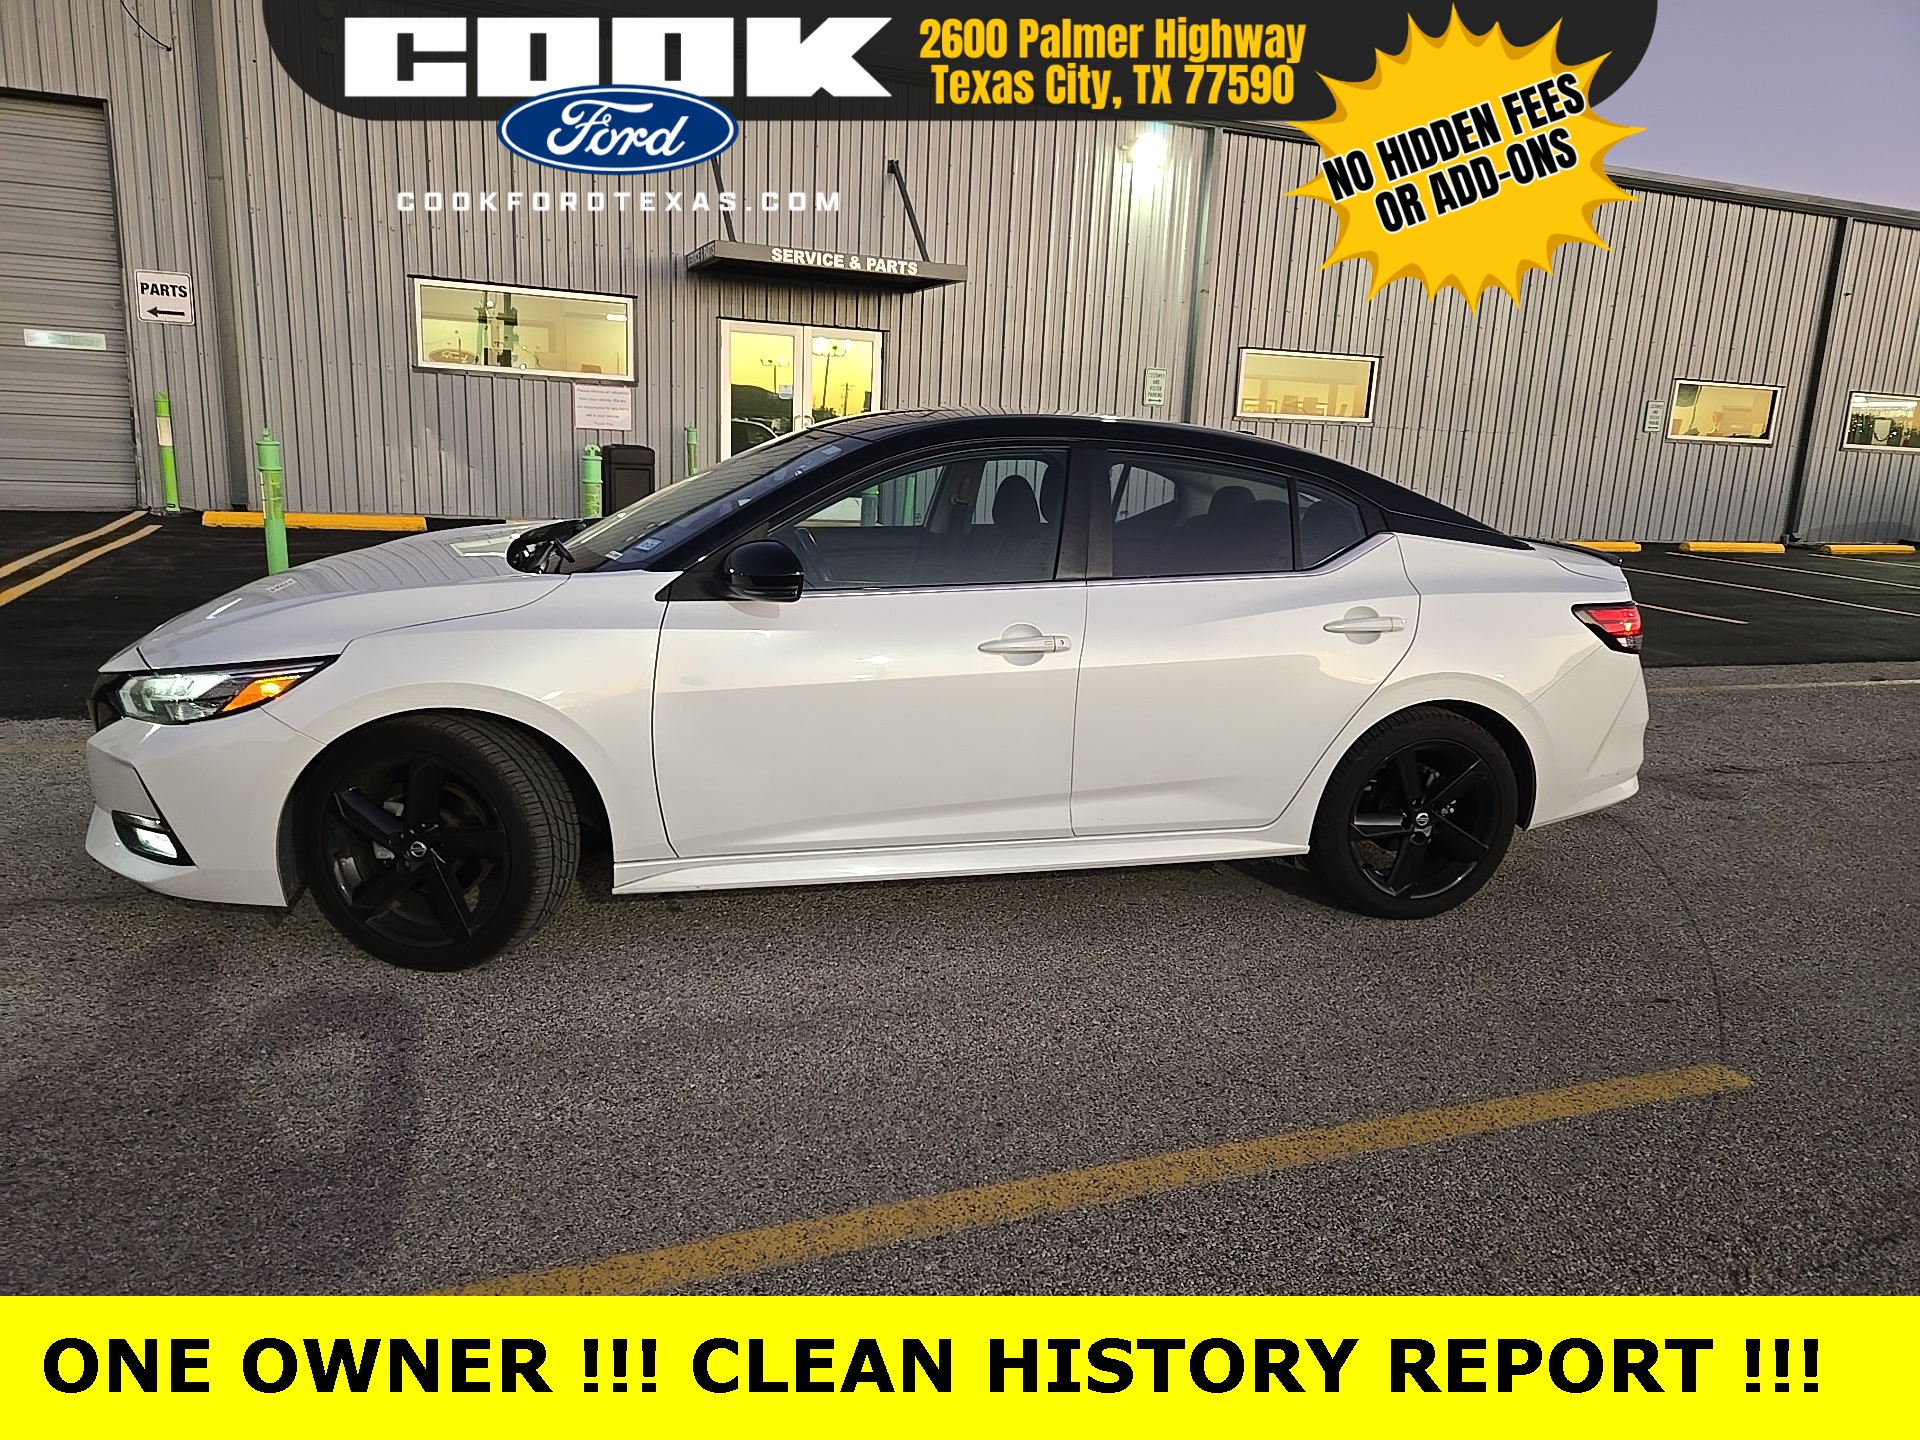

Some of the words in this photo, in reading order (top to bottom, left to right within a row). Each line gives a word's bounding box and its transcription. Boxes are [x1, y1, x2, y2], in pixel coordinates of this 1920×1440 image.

[771, 247, 845, 268] SERVICE
[849, 255, 861, 270] &
[866, 257, 918, 276] PARTS
[140, 281, 188, 298] PARTS
